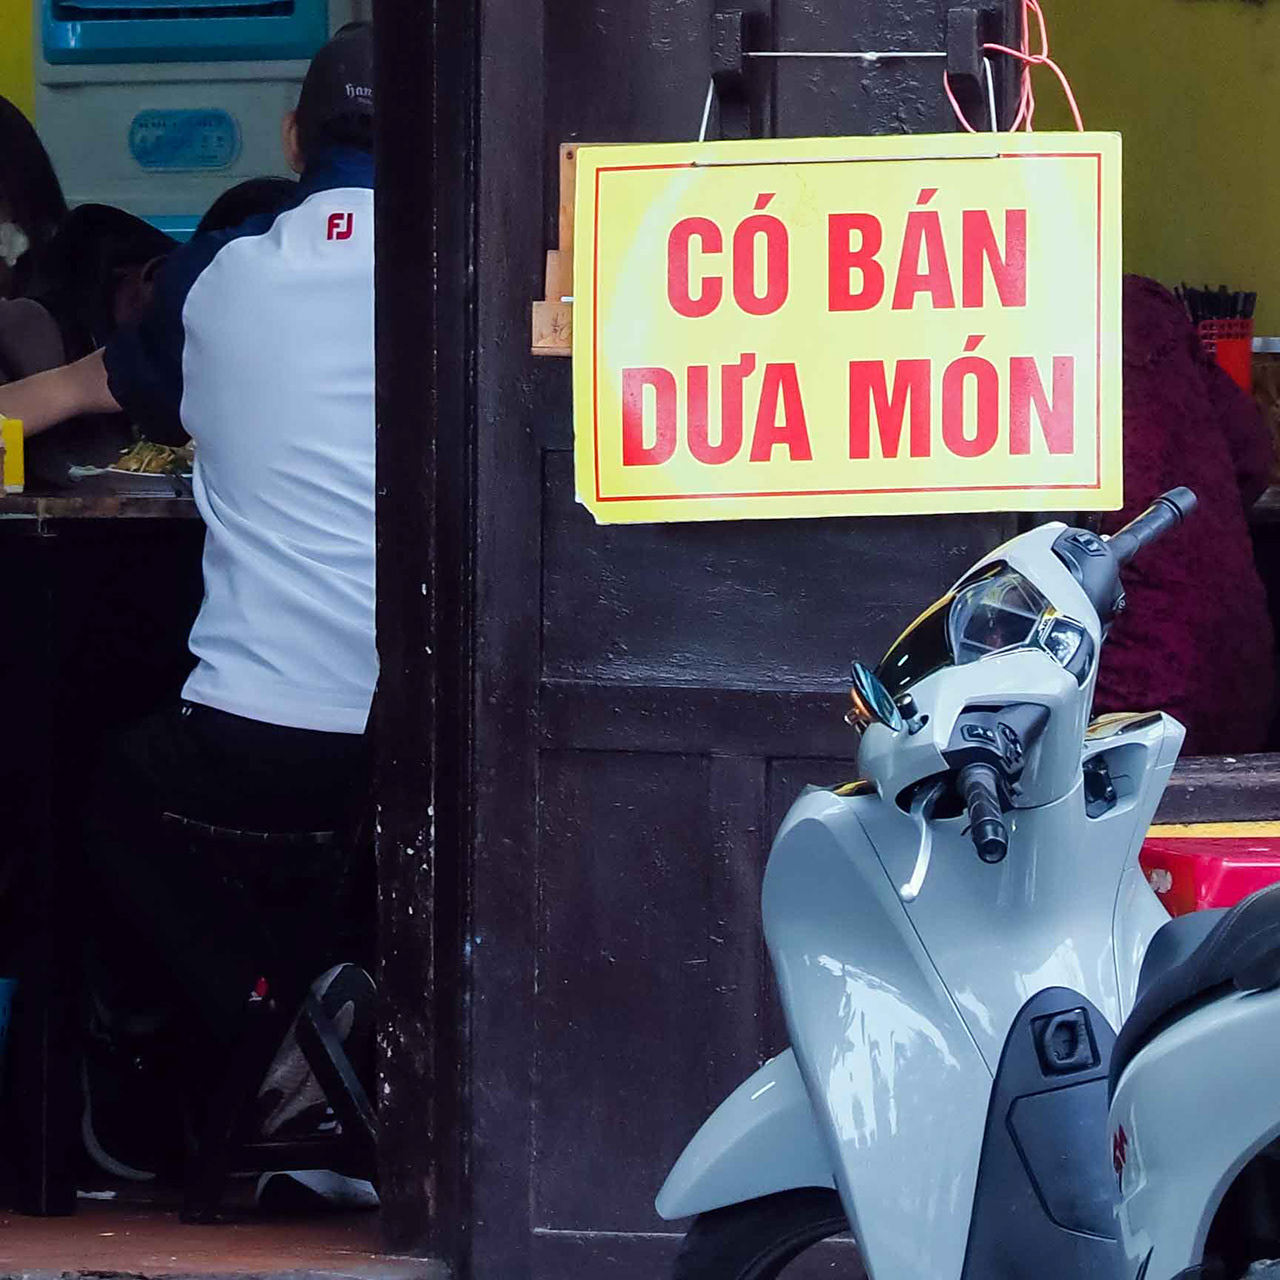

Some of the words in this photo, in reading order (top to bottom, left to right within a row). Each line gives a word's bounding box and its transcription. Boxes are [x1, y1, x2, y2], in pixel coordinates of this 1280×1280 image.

[326, 212, 354, 241] FJ
[667, 193, 790, 319] CÓ
[827, 188, 1027, 312] BÁN
[622, 352, 814, 467] DƯA
[848, 334, 1075, 460] MÓN
